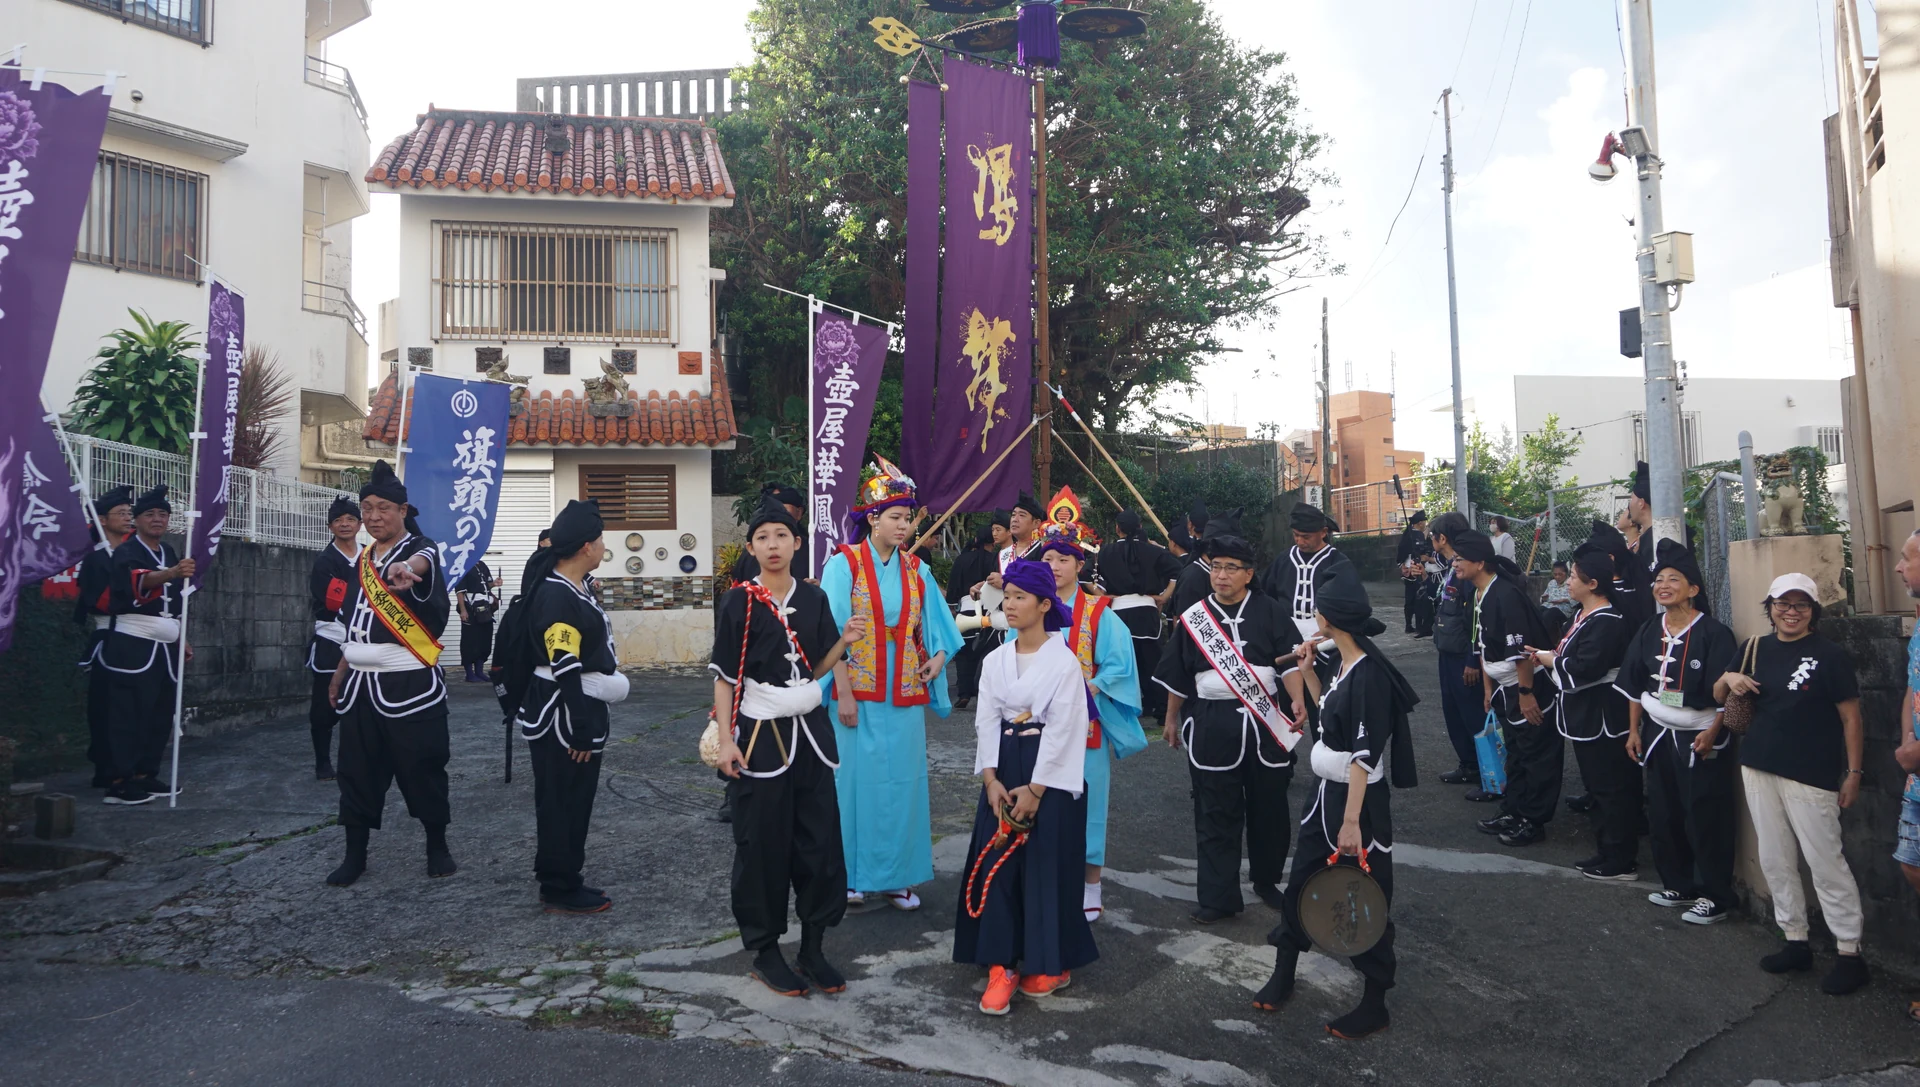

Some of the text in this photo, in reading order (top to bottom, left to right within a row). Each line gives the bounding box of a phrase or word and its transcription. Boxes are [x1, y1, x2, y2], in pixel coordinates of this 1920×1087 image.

[546, 629, 572, 650] 写真
[1189, 609, 1272, 717] 壺屋焼物博物館
